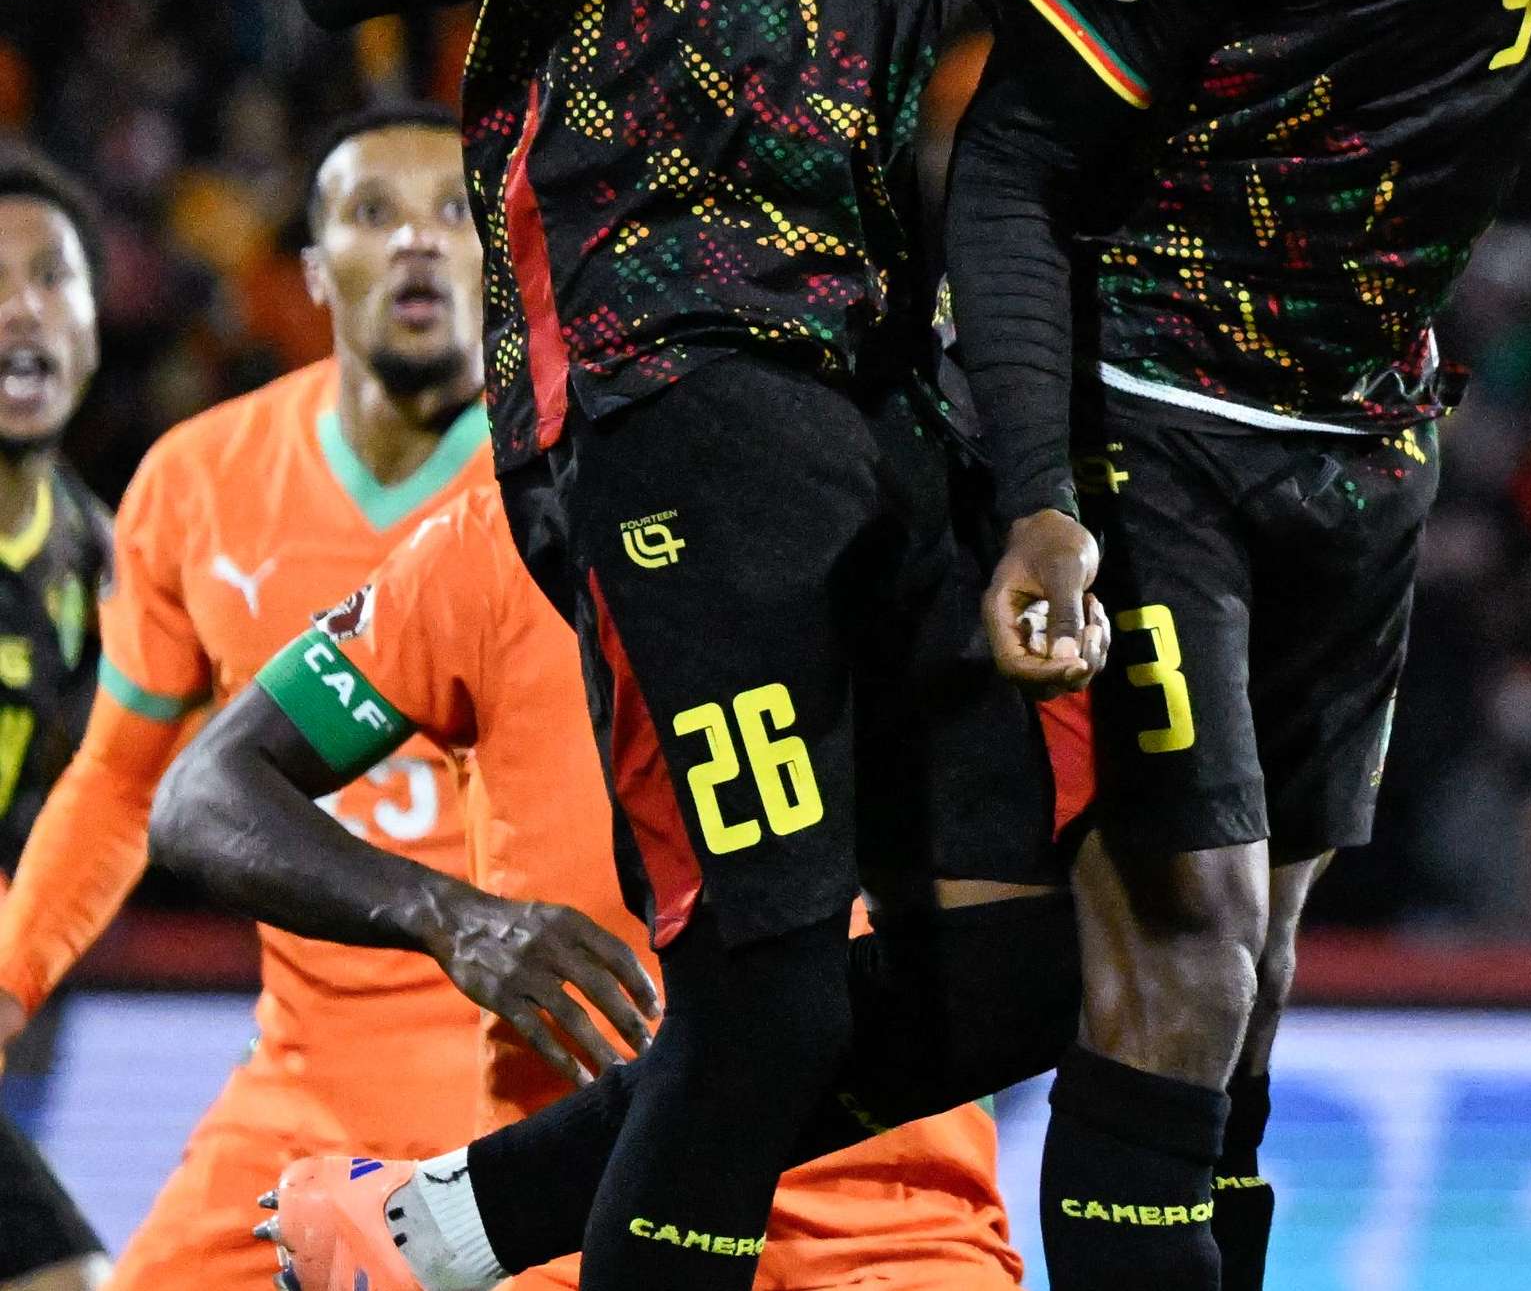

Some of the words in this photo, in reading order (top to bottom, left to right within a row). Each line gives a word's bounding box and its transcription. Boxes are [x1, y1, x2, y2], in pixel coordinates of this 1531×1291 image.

[619, 509, 679, 532] FOURTEEN
[303, 642, 388, 731] CAF
[1116, 604, 1196, 754] 3
[673, 682, 825, 855] 26
